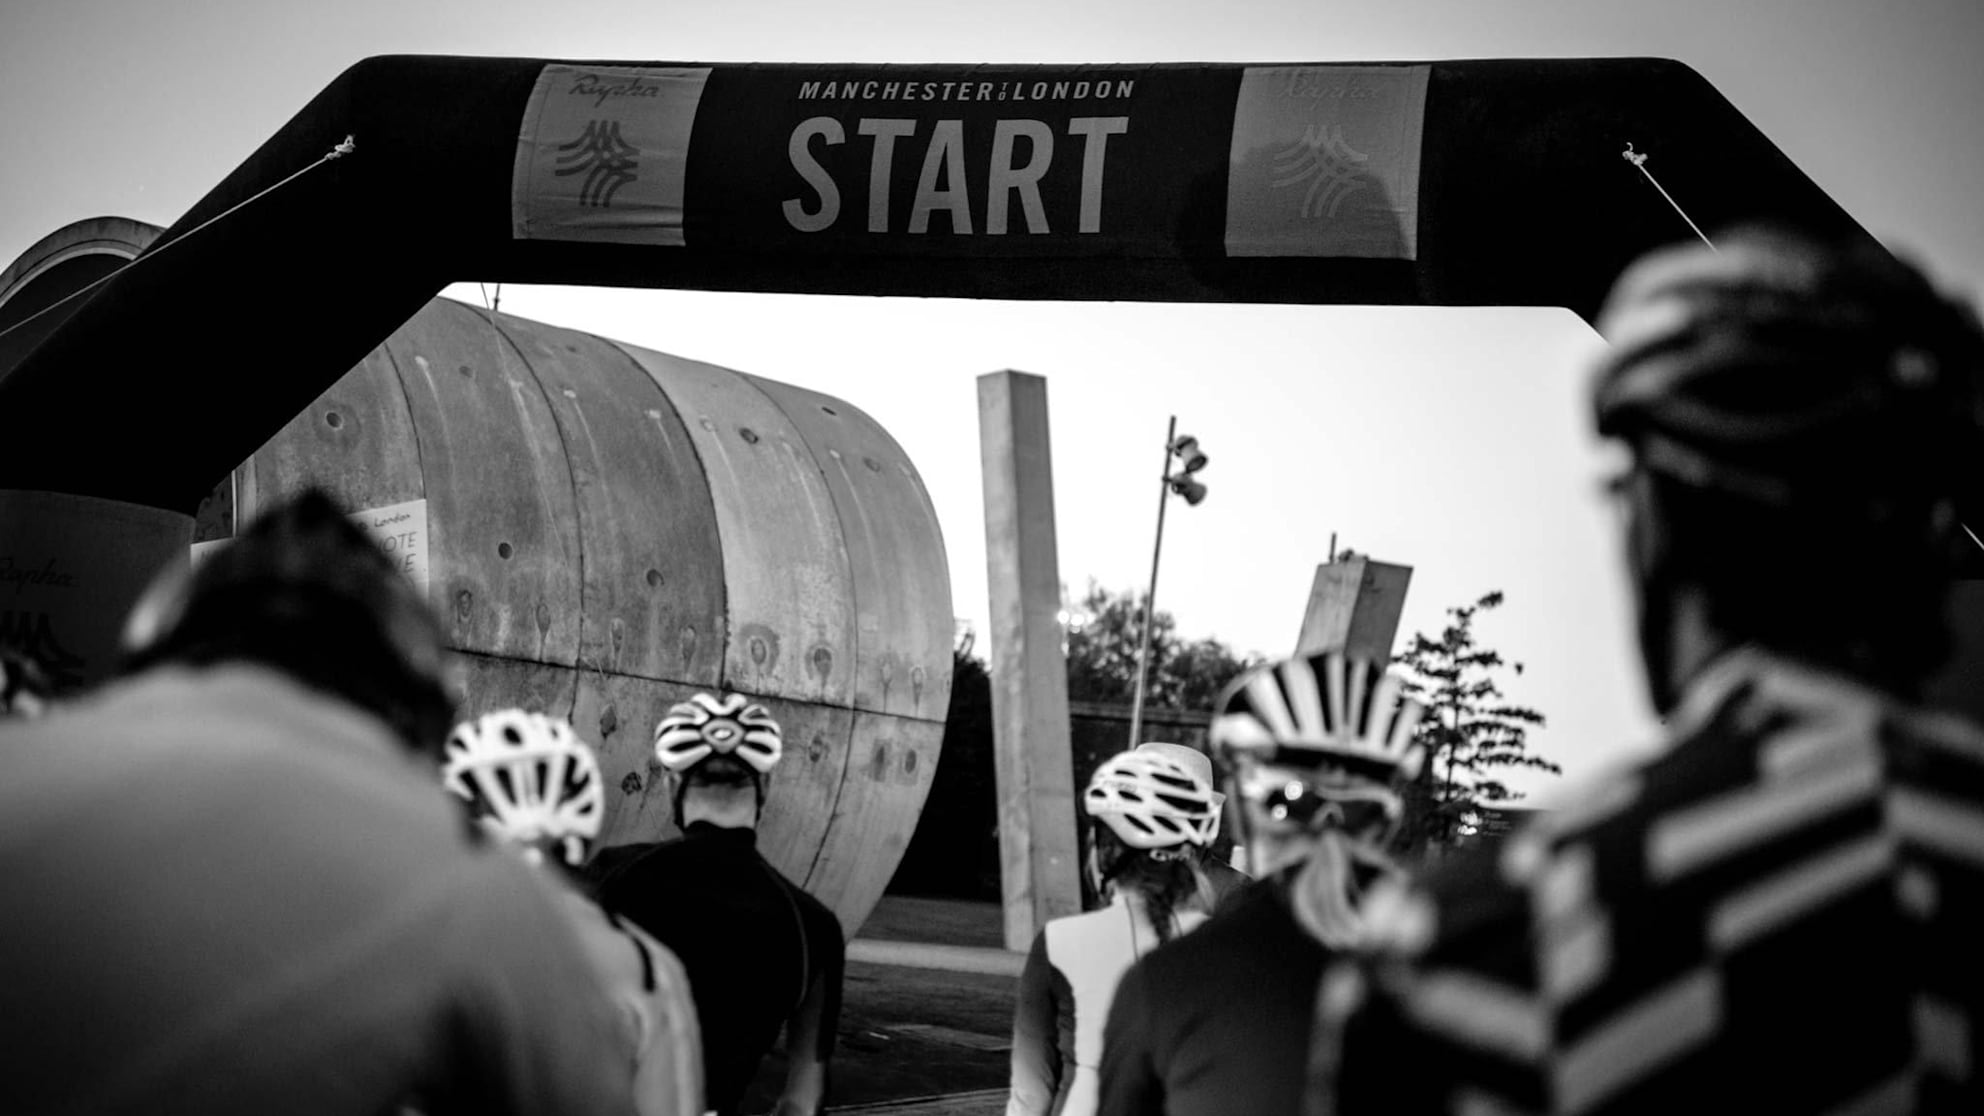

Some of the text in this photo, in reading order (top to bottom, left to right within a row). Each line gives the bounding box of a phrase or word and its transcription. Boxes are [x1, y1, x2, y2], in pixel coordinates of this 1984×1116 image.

[568, 74, 660, 108] Rapha
[798, 80, 994, 101] MANCHESTER
[1012, 80, 1135, 101] LONDON
[782, 116, 1130, 235] START
